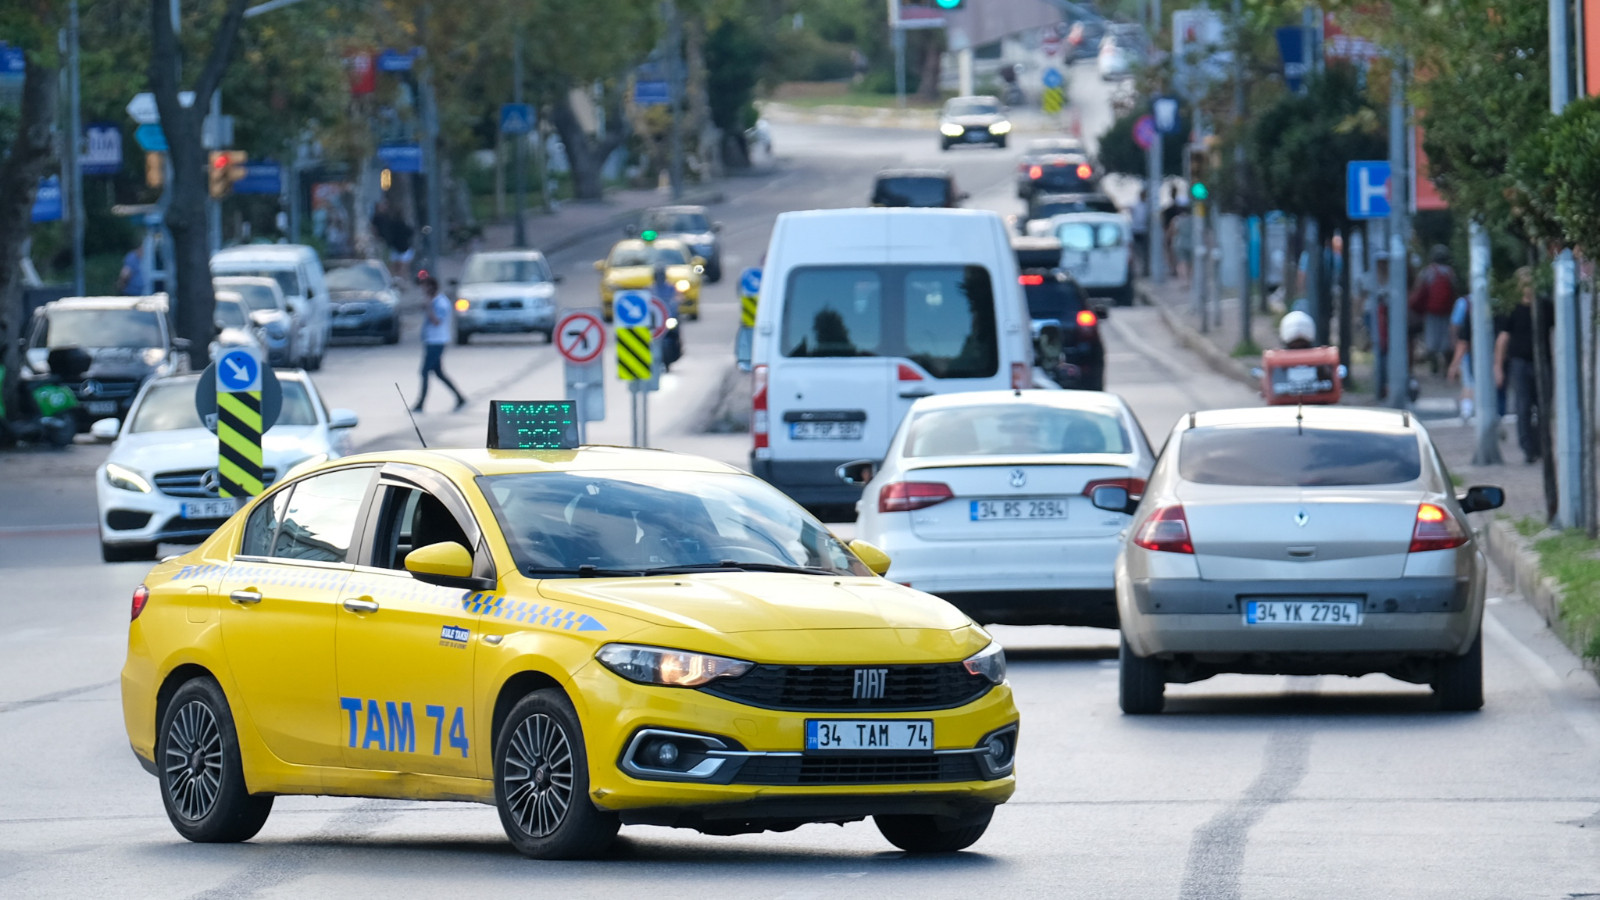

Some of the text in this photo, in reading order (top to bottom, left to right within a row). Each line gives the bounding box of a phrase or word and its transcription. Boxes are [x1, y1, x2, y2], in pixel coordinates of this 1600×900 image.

[981, 501, 1064, 517] 34 RS 2694
[1257, 603, 1351, 622] 34 YK 2794
[852, 668, 888, 699] FIAT
[340, 696, 469, 758] TAM 74
[820, 724, 928, 747] 34 TAM 74
